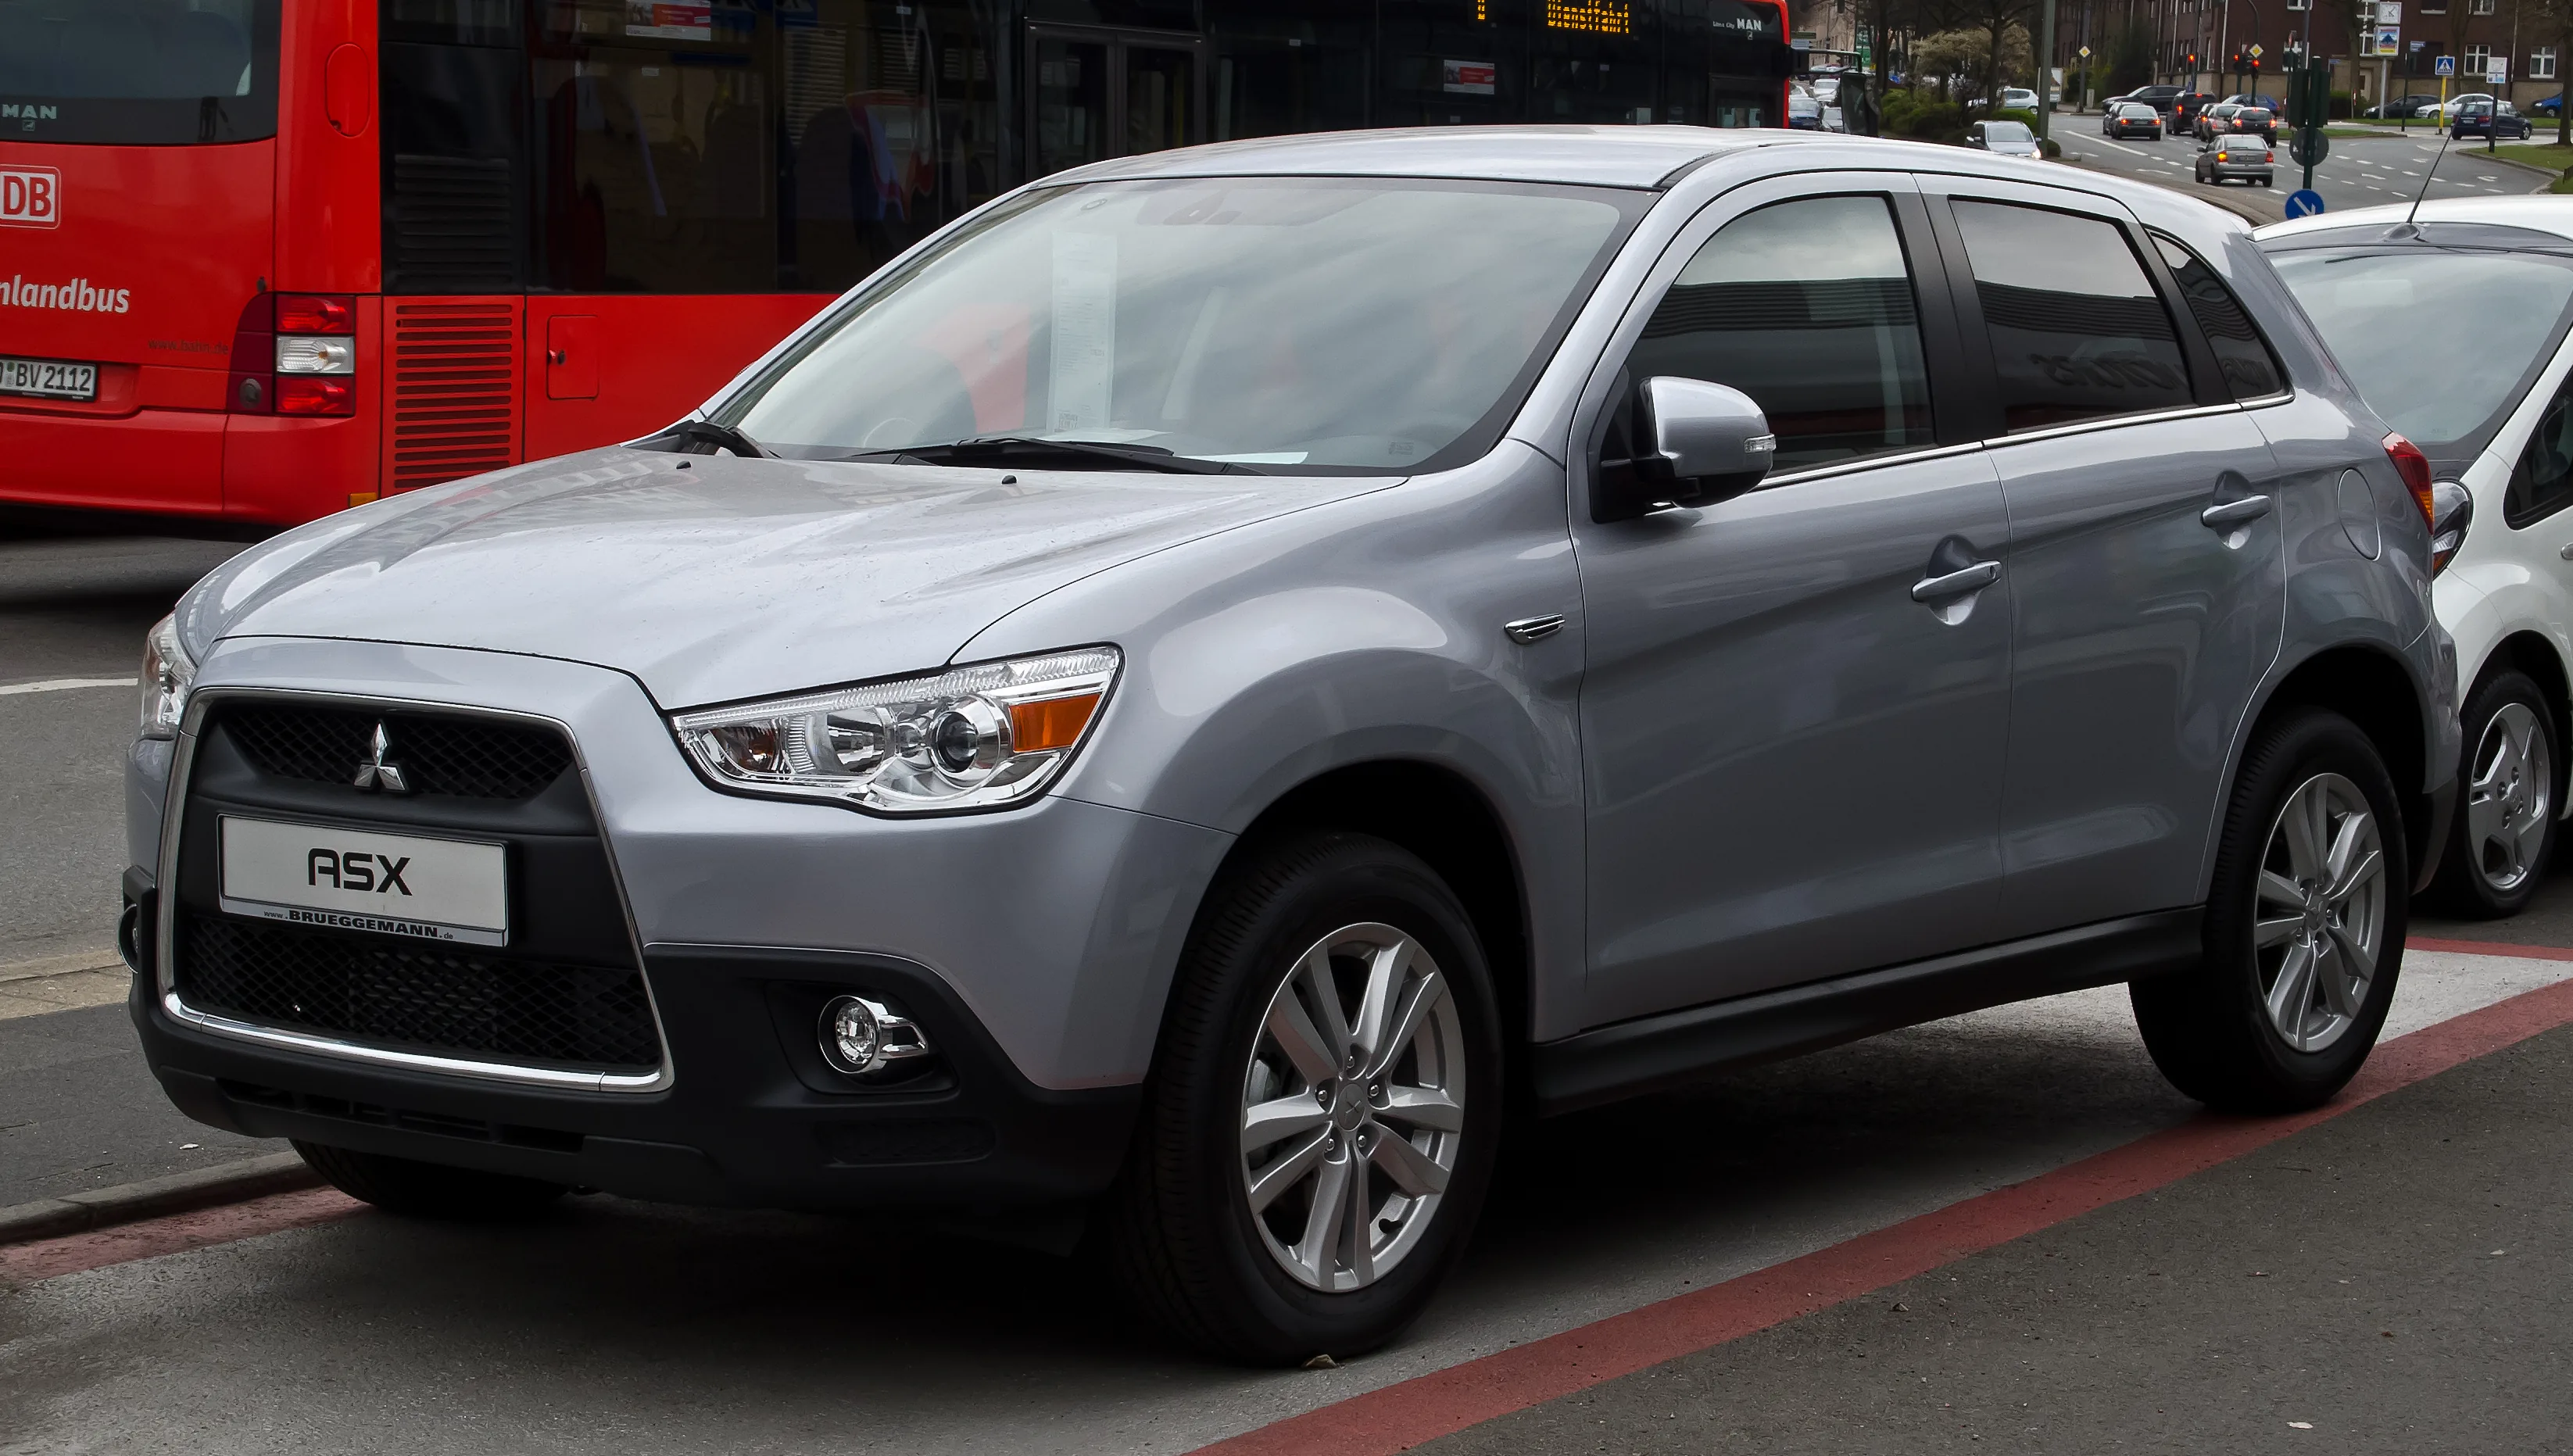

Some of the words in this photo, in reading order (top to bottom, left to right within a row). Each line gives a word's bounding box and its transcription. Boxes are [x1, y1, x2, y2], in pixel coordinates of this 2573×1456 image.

[1737, 18, 1762, 31] MAN
[2, 104, 57, 120] MAN
[3, 175, 52, 217] DB
[148, 338, 228, 356] www.bahn.de
[44, 365, 91, 392] 2112
[308, 847, 413, 896] ASX
